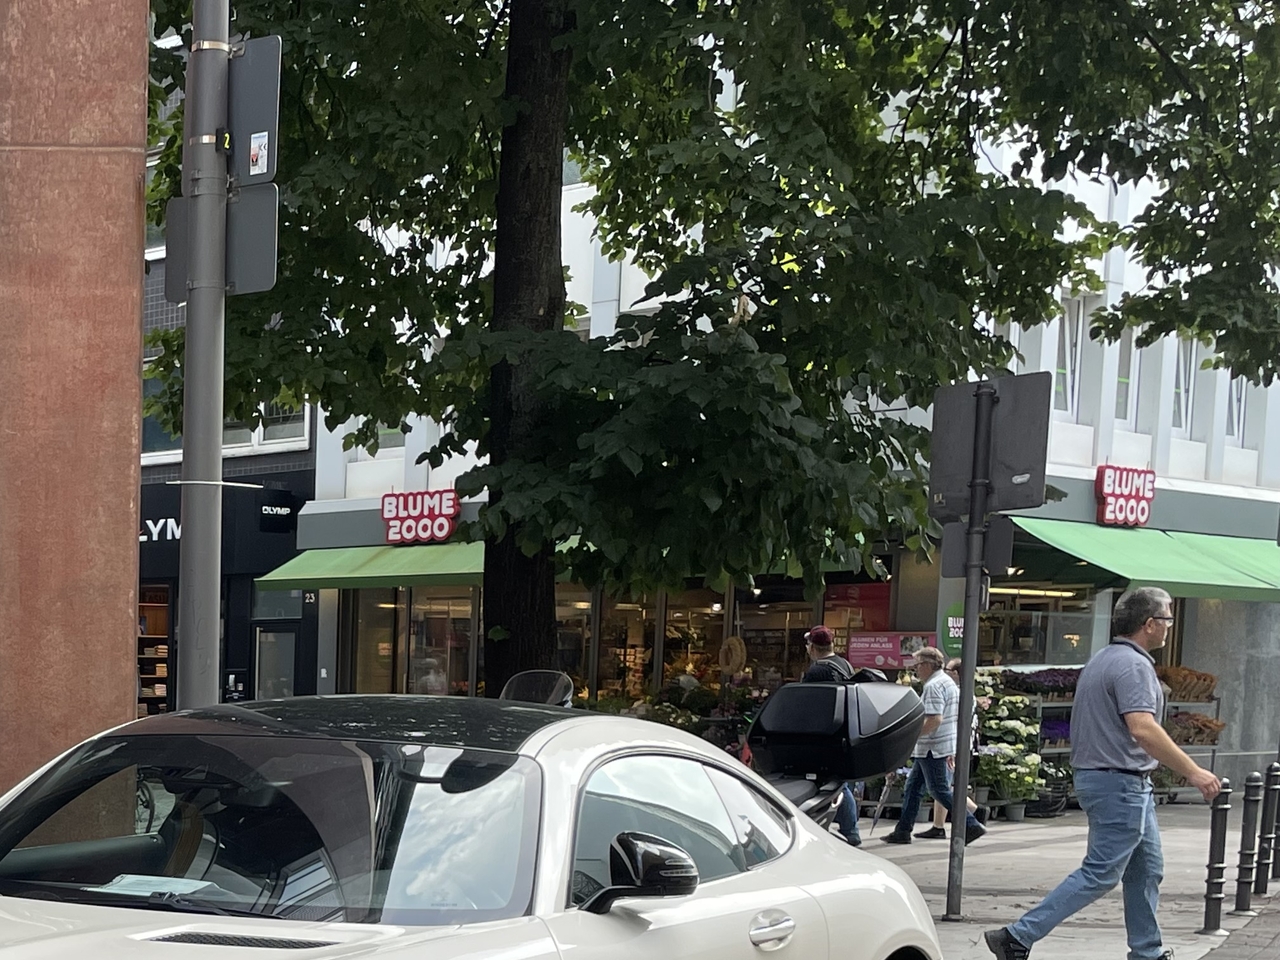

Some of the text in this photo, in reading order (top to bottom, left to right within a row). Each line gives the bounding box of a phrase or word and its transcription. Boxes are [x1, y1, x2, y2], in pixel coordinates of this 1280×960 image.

[1103, 468, 1155, 498] BLUME
[261, 505, 291, 516] OLYMP
[383, 492, 455, 518] BLUME
[1105, 496, 1149, 523] 2000
[388, 517, 449, 541] 2000
[305, 593, 315, 603] 23
